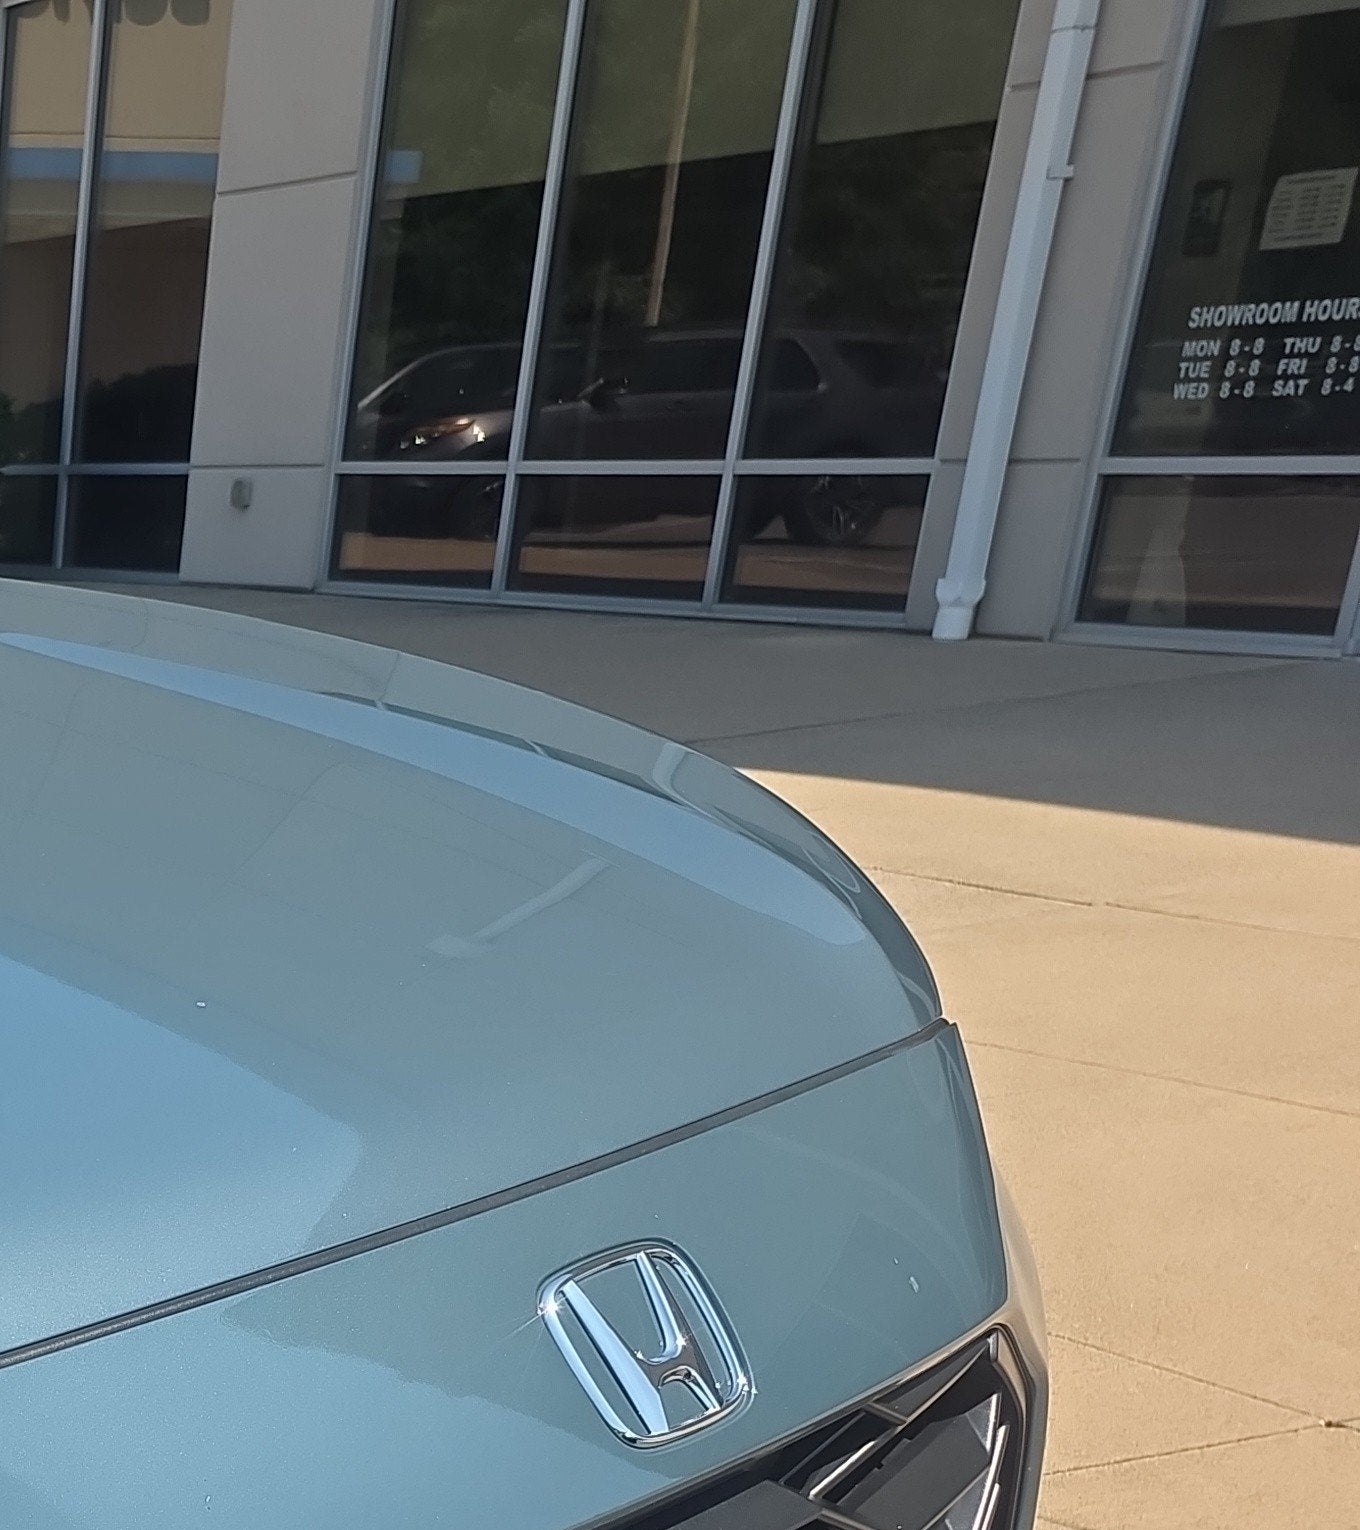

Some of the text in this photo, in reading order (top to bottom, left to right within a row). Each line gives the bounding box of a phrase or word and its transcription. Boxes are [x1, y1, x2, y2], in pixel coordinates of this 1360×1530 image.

[1188, 297, 1360, 328] SHOWROOM HOUR
[1181, 338, 1221, 357] MON
[1283, 336, 1322, 354] THU
[1179, 361, 1212, 378] TUE
[1277, 357, 1308, 375] FRI
[1173, 382, 1209, 400] WED
[1272, 378, 1310, 397] SAT
